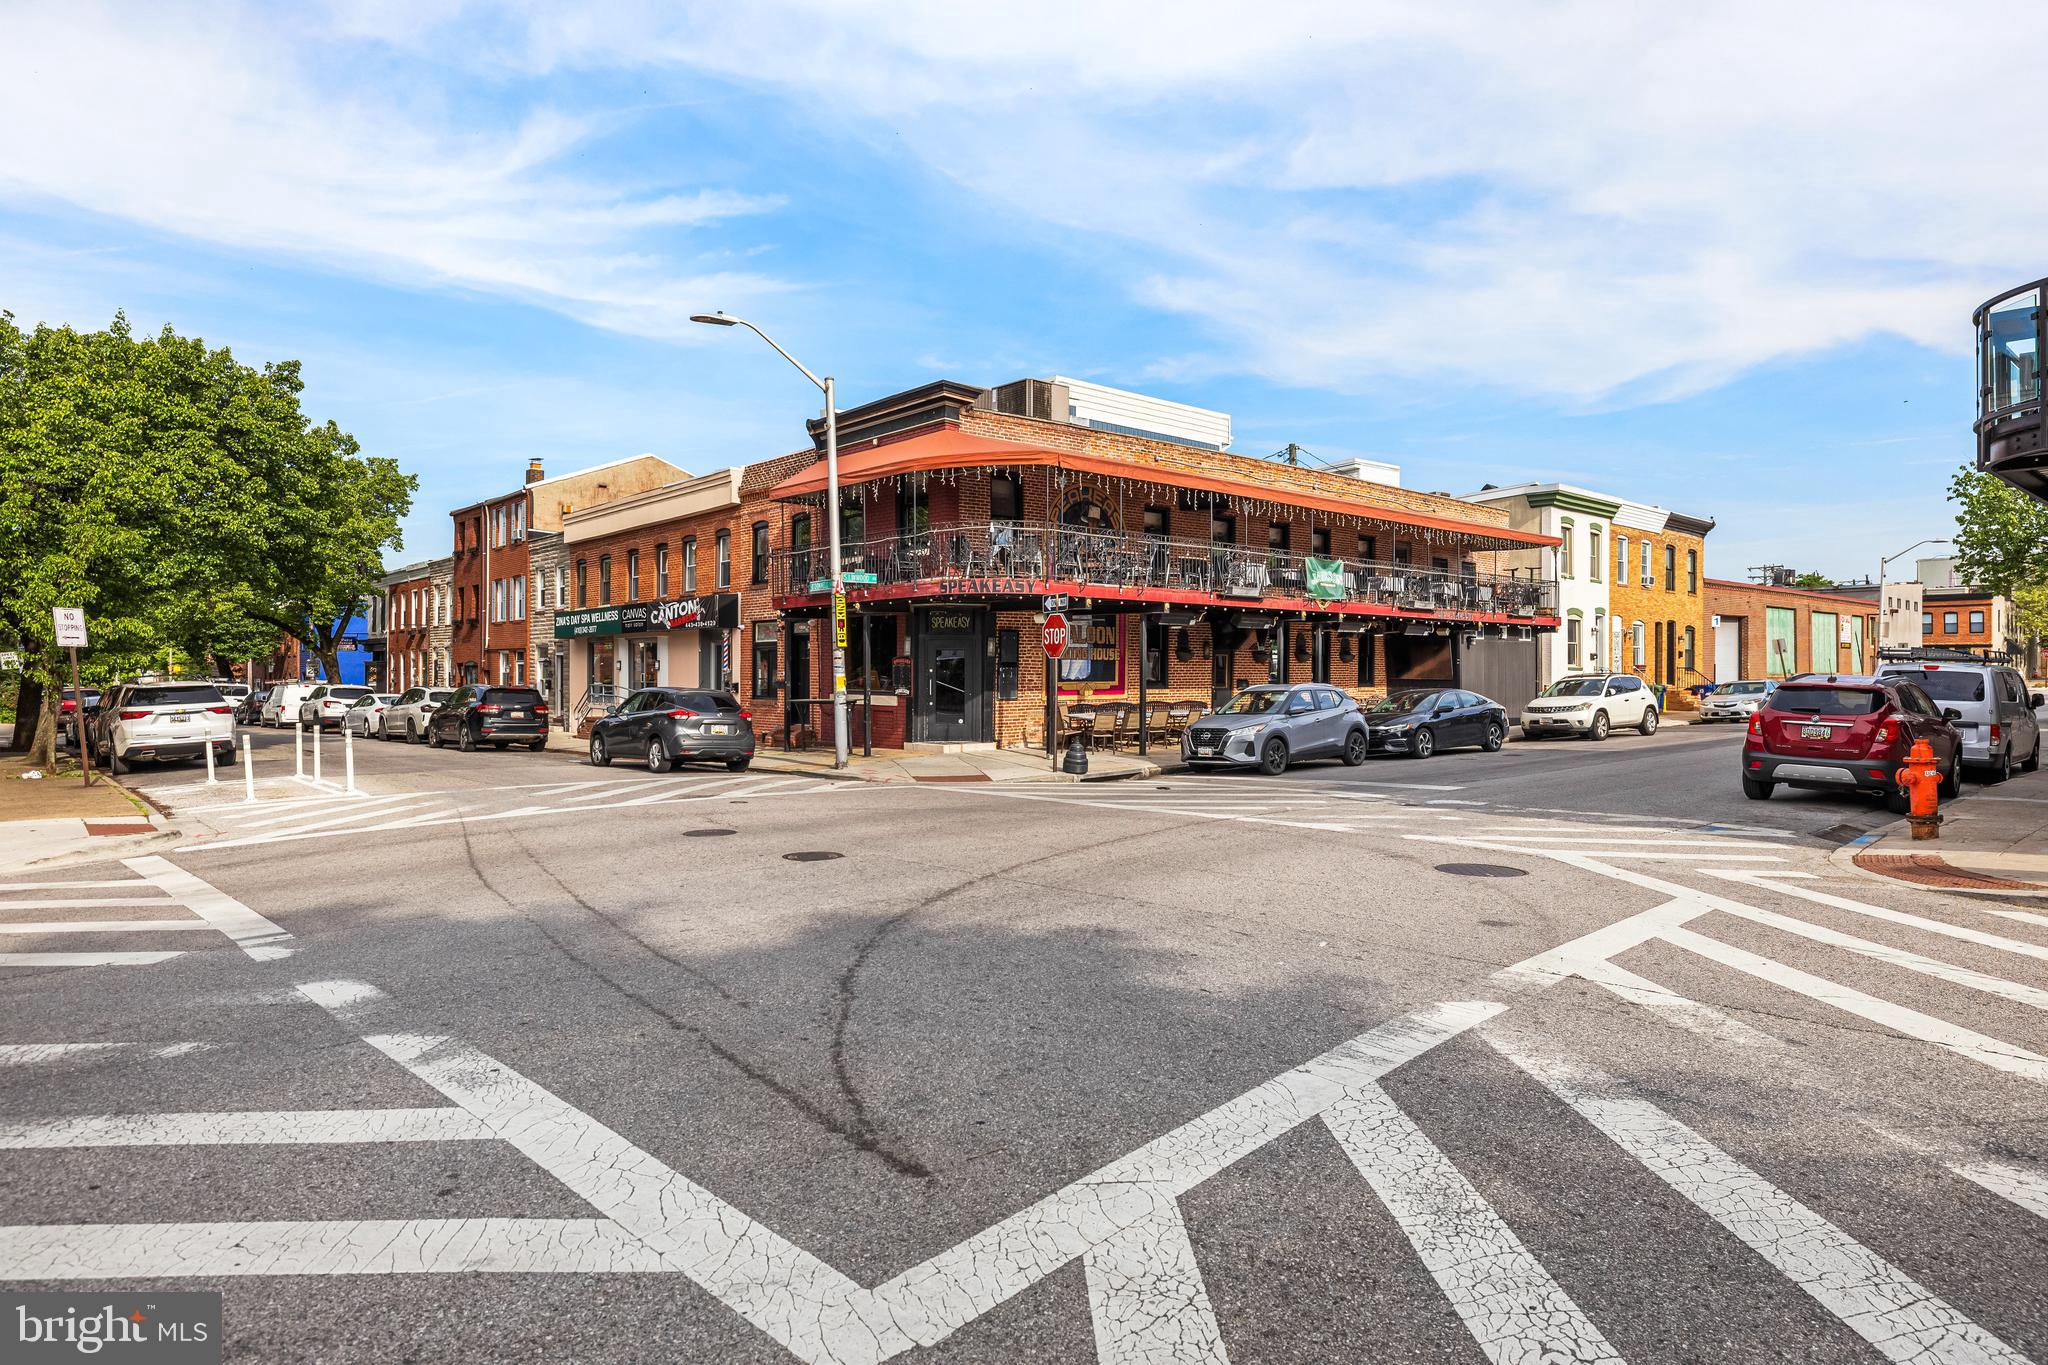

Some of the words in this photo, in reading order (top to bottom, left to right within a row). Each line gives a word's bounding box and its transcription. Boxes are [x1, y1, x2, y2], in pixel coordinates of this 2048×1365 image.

[939, 578, 1037, 594] SPEAKEASY
[63, 612, 75, 621] NO
[621, 607, 647, 620] CANVAS
[650, 599, 697, 624] CANTON
[555, 616, 570, 627] ZINA'S
[570, 615, 581, 625] DAY
[581, 613, 591, 624] SPA
[591, 610, 619, 622] WELLNESS
[931, 616, 971, 629] SPEAKEASY
[1714, 617, 1719, 625] 1
[58, 624, 83, 632] STOPPING
[1044, 628, 1066, 645] STOP
[1070, 626, 1115, 645] ALOON
[1090, 647, 1120, 660] HOUSE
[307, 667, 319, 675] 25
